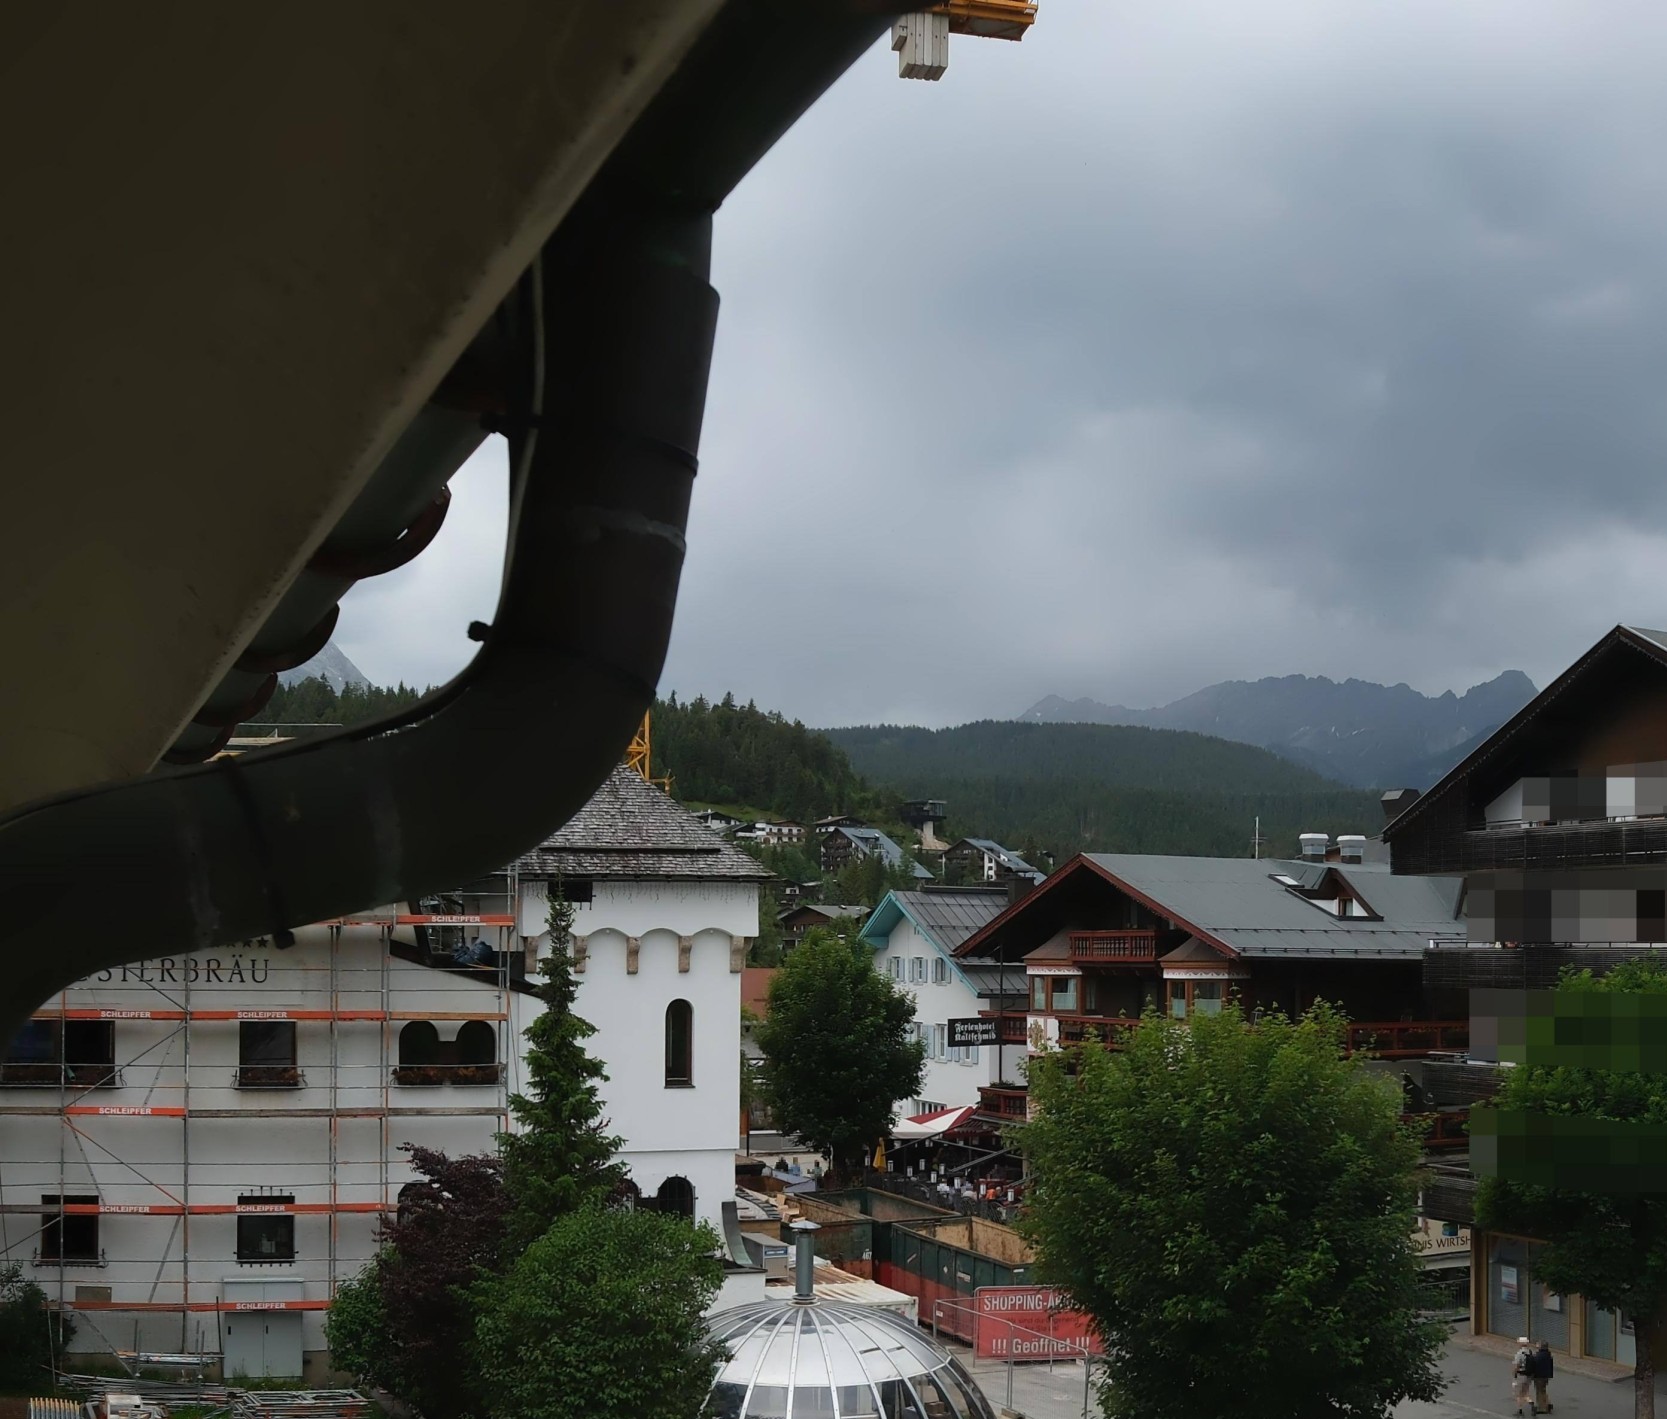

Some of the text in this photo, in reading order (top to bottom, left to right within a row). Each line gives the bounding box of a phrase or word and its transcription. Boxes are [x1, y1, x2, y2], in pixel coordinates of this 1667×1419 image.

[431, 915, 481, 923] SCHLEIPFER
[100, 1011, 151, 1019] SCHLEIPFER
[237, 1011, 288, 1019] SCHLEIPFER
[98, 1107, 152, 1115] SCHLEIPFER
[99, 1205, 150, 1213] SCHLEIPFER
[235, 1205, 286, 1213] SCHLEIPFER
[235, 1302, 286, 1310] SCHLEIPFER
[1012, 1337, 1070, 1354] Geöffnet
